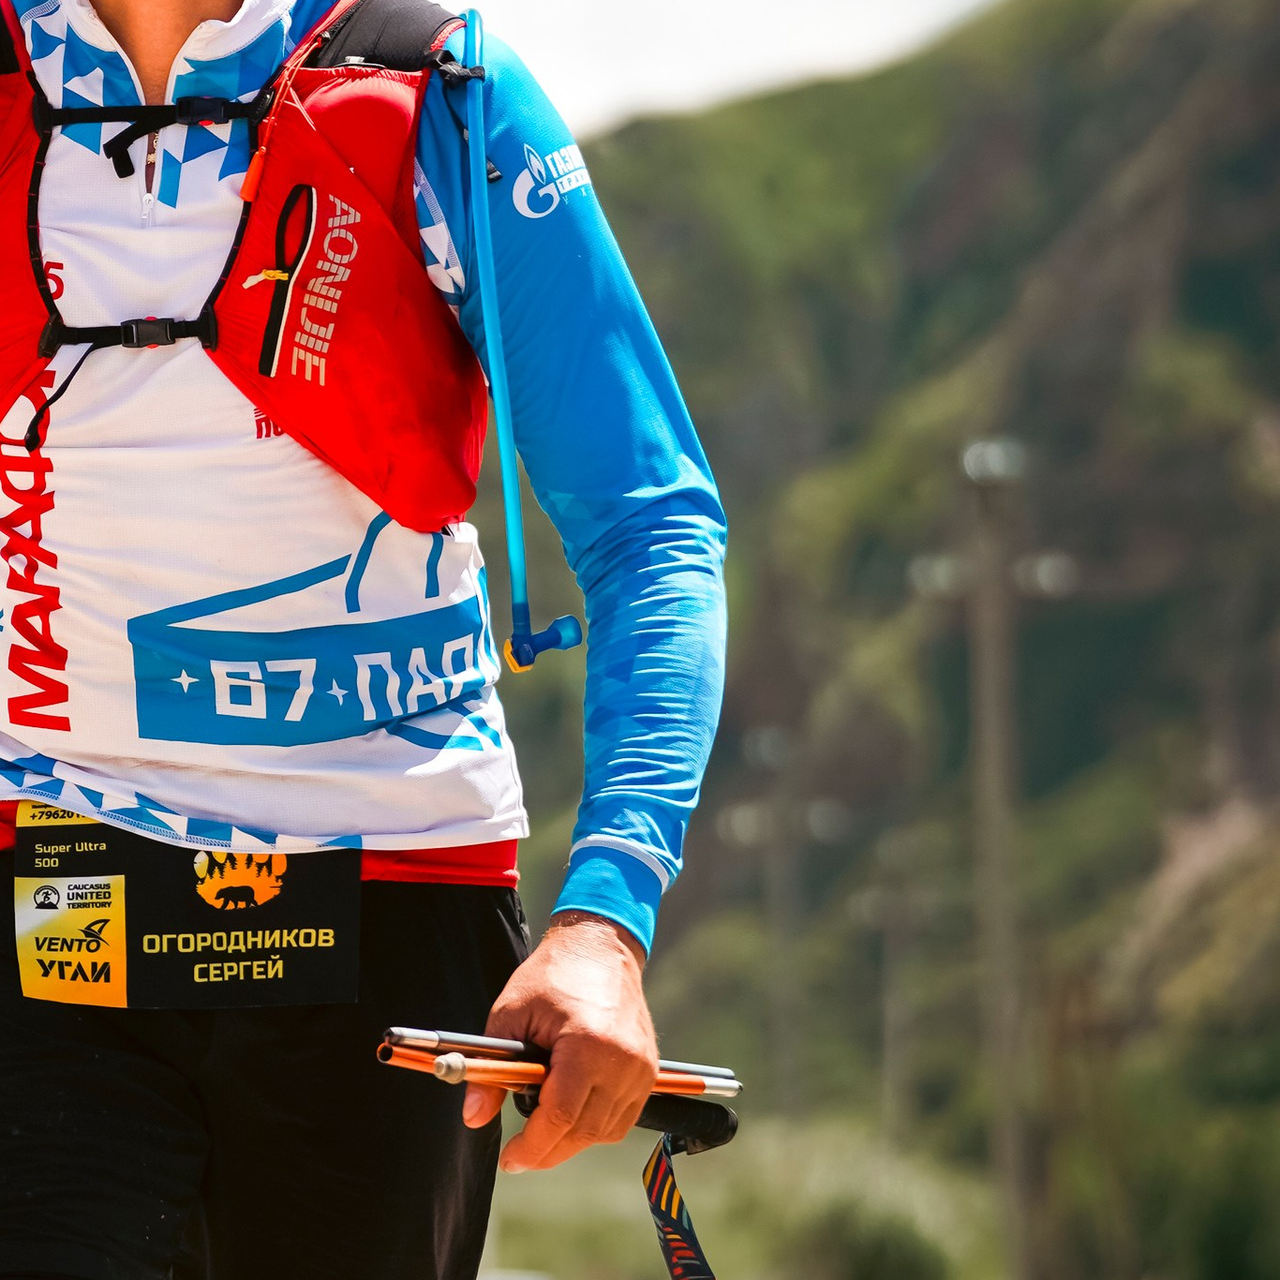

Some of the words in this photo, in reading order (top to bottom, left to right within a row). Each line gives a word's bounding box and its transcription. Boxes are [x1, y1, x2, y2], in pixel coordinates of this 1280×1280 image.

[291, 194, 361, 387] AONIJIE
[210, 658, 317, 722] 67
[35, 843, 71, 855] Super
[75, 842, 107, 852] Ultra
[34, 857, 59, 868] 500
[67, 883, 111, 891] CAUCASUS
[67, 891, 111, 901] UNITED
[67, 901, 112, 909] TERRITORY
[35, 936, 101, 953] VENTO
[142, 928, 335, 954] ОГОРОДНИКОВ
[36, 958, 111, 983] УГЛИ
[193, 954, 284, 983] СЕРГЕЙ
